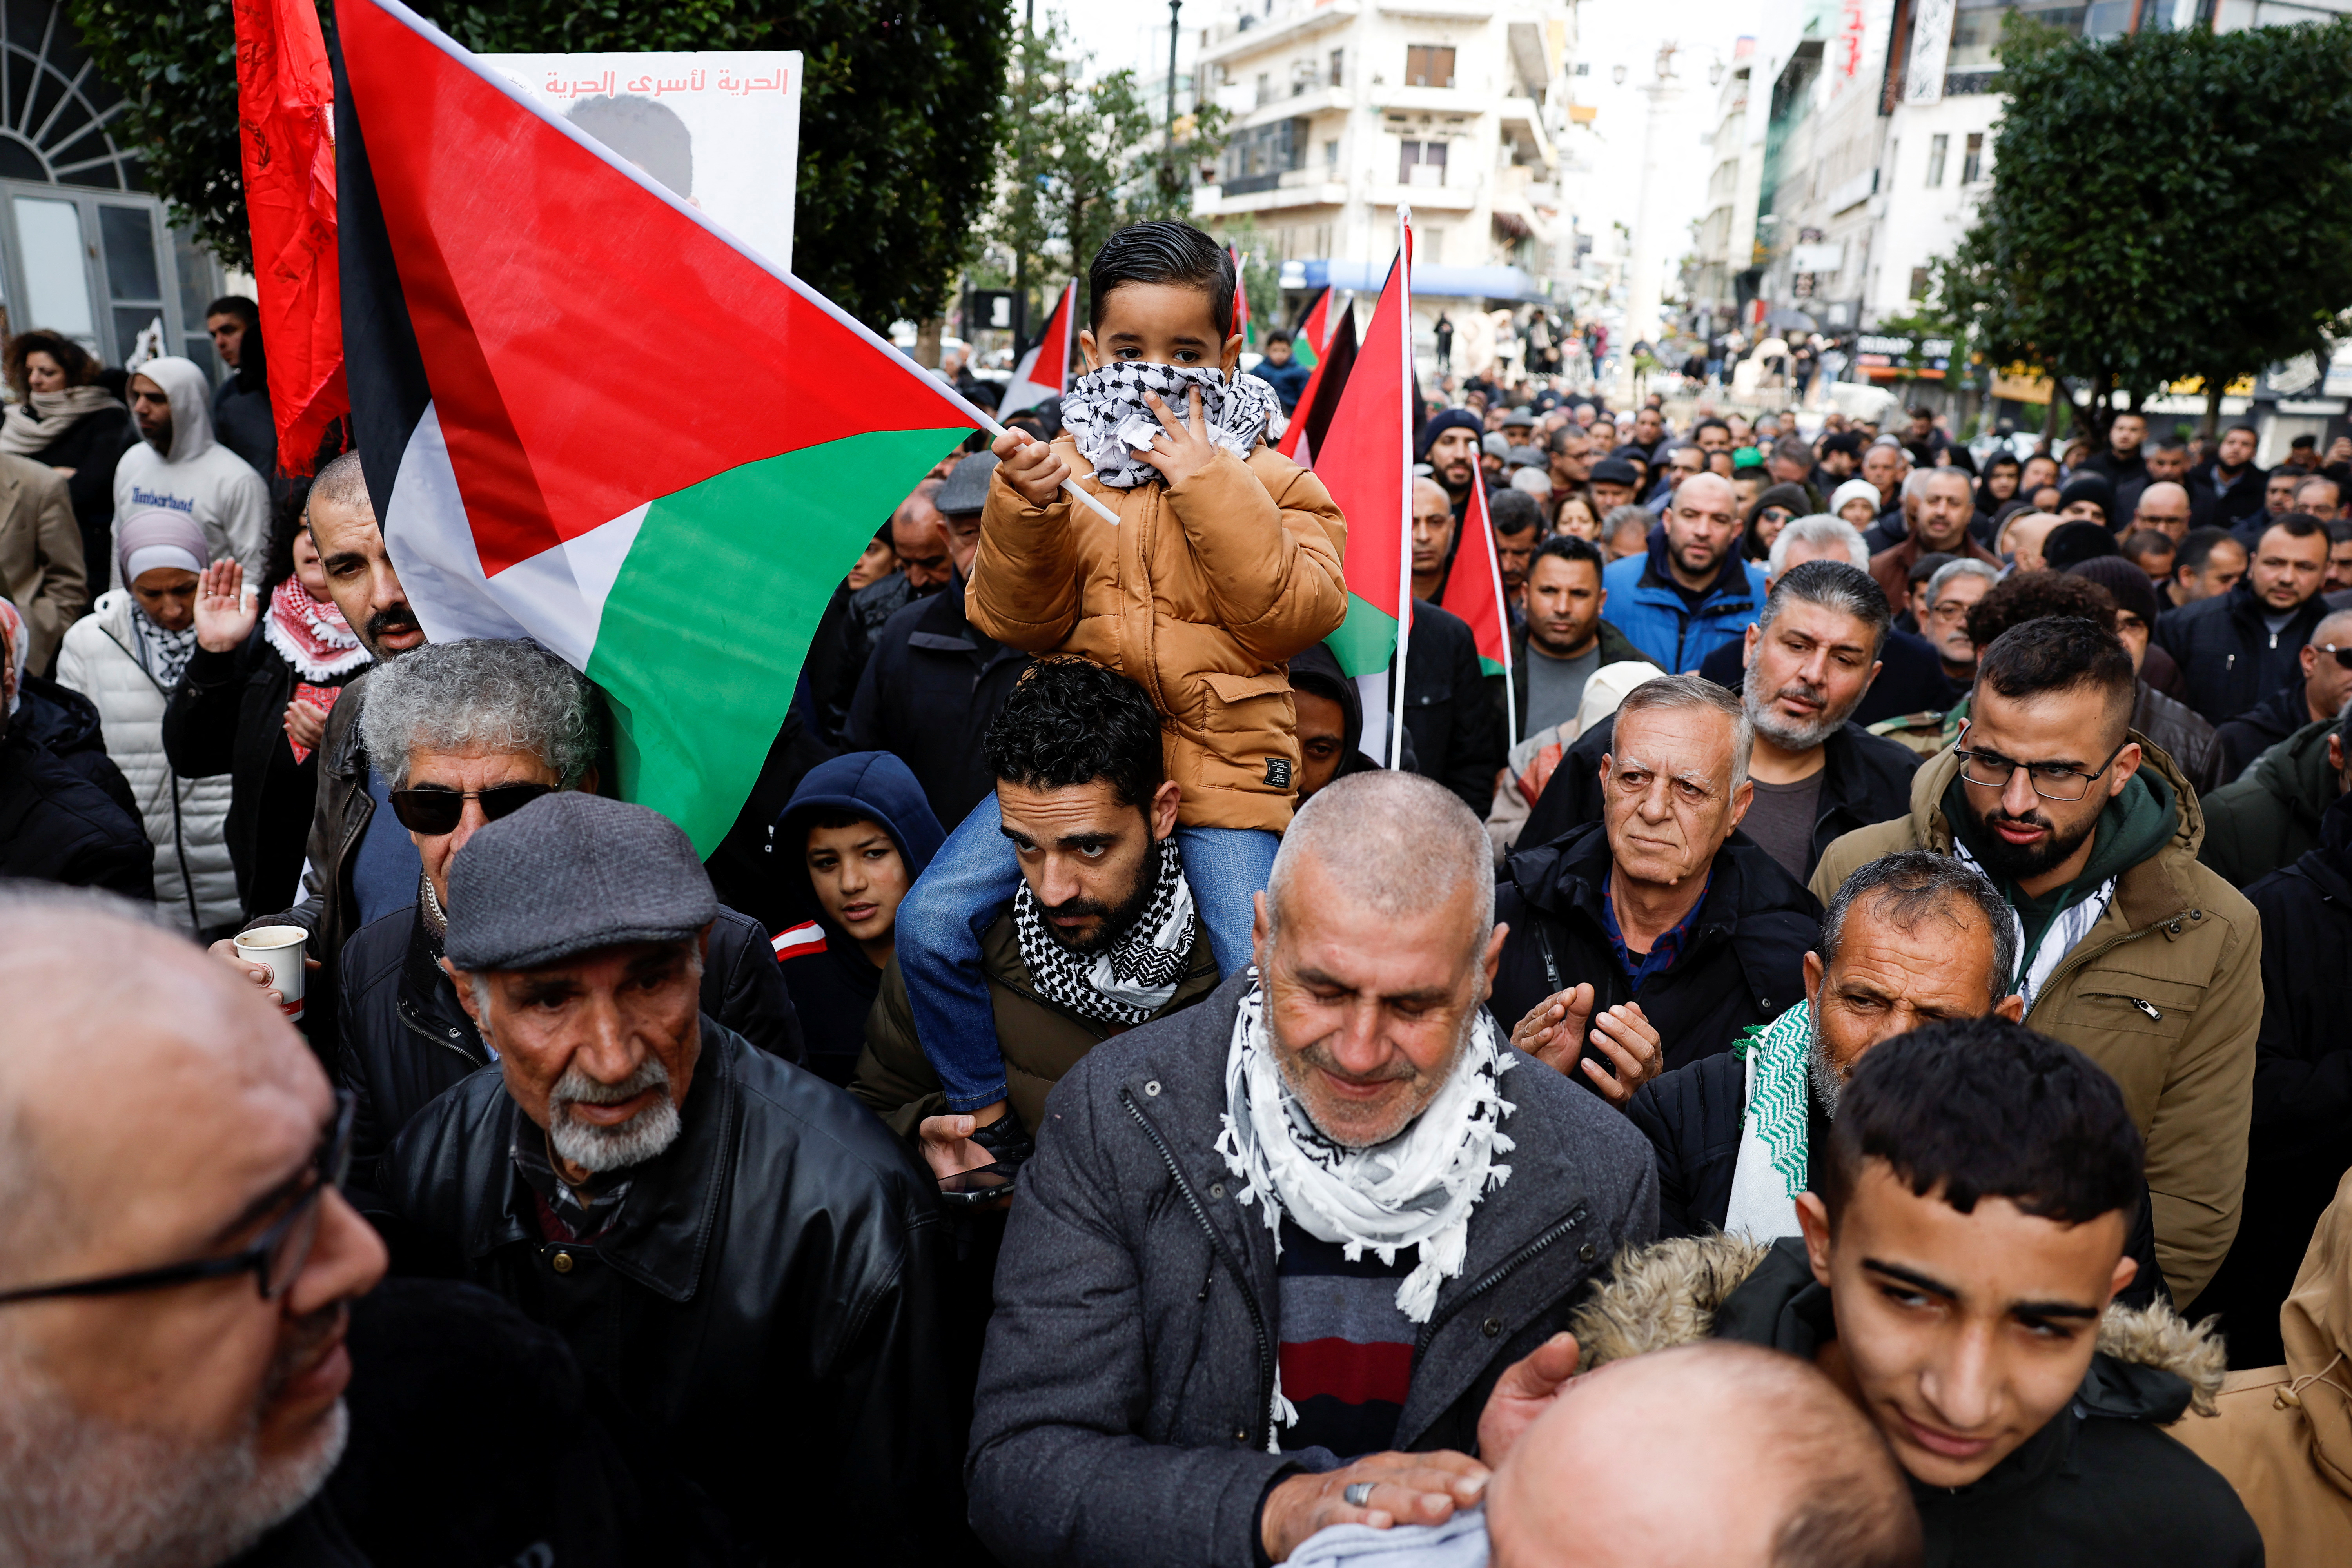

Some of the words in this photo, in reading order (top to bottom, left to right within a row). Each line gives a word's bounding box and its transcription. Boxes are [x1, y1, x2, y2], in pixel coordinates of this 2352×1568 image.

[545, 71, 615, 98] الحرية
[628, 69, 706, 97] لأسرى
[718, 69, 788, 96] الحرية
[132, 487, 194, 512] Timberland
